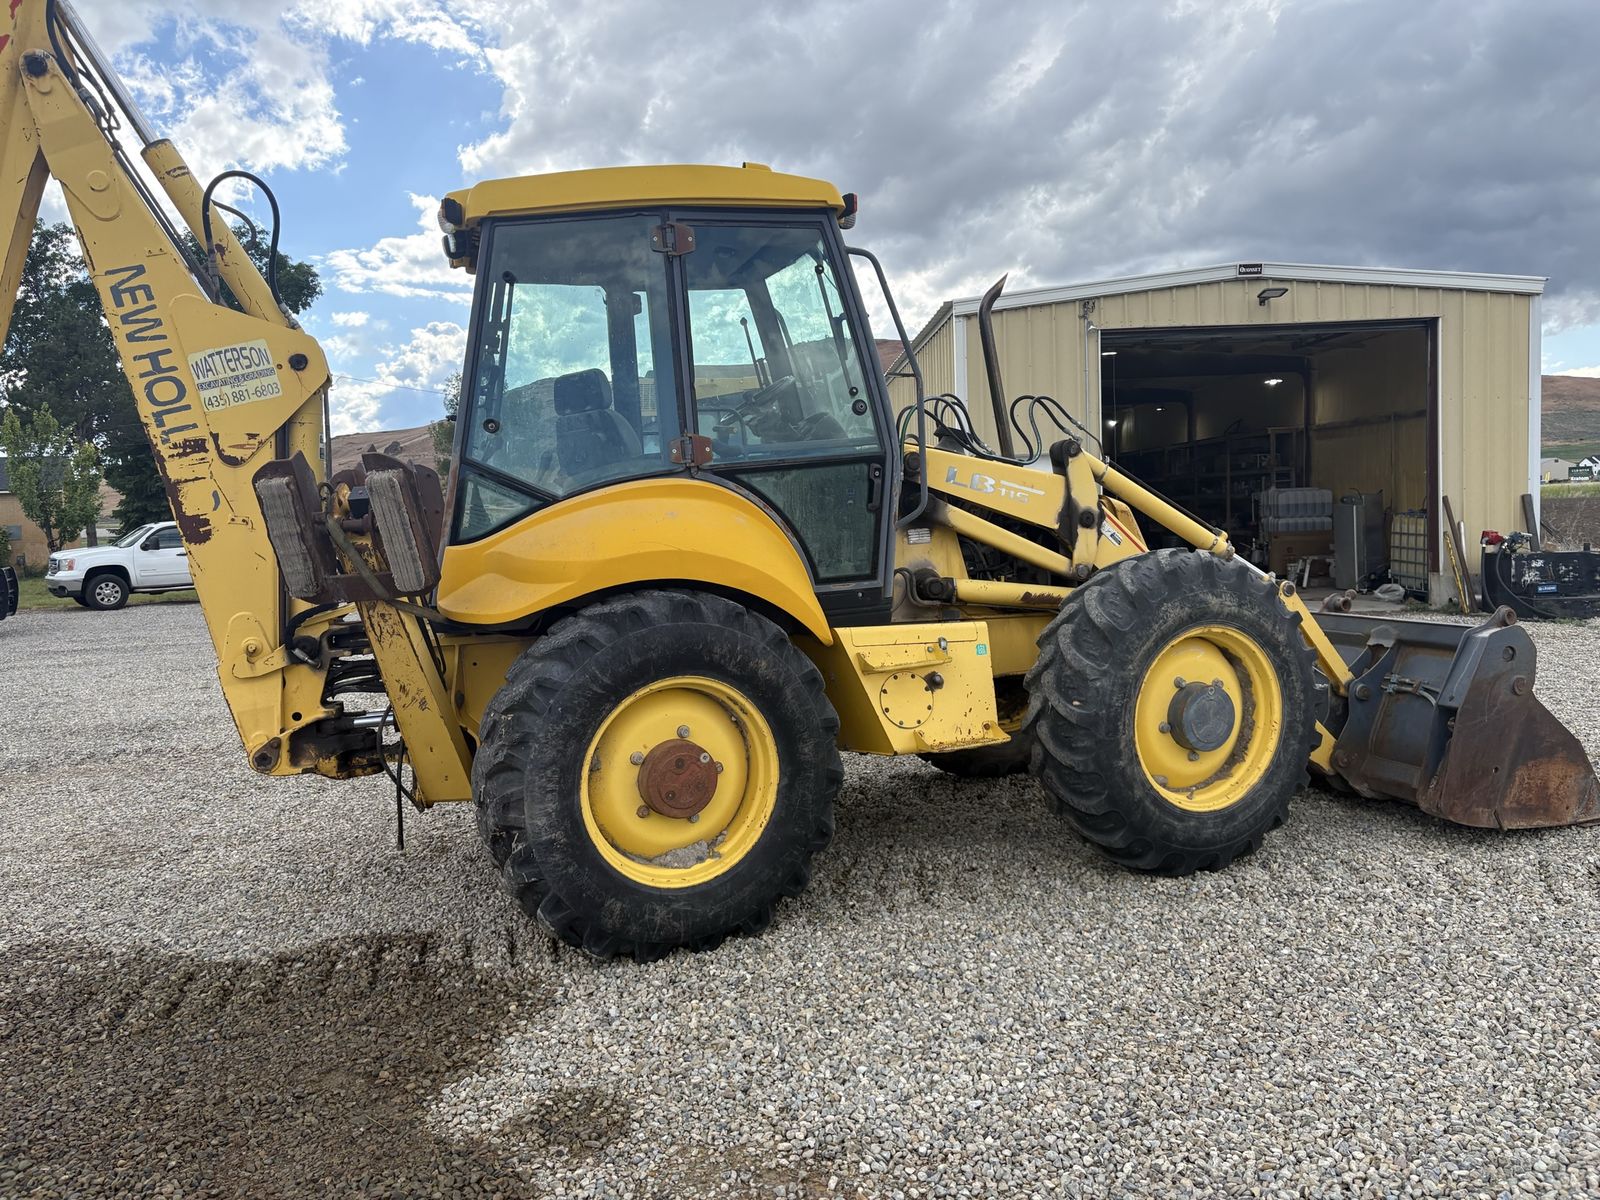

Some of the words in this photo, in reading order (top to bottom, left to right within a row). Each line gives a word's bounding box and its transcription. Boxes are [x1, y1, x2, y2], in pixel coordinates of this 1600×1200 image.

[104, 264, 168, 343] NEW
[191, 346, 271, 380] WATTERSON
[198, 376, 240, 391] EXCAVATING
[244, 368, 275, 383] GRADING
[204, 392, 230, 411] (435)
[231, 382, 280, 403] 881-6803
[945, 466, 996, 493] LB
